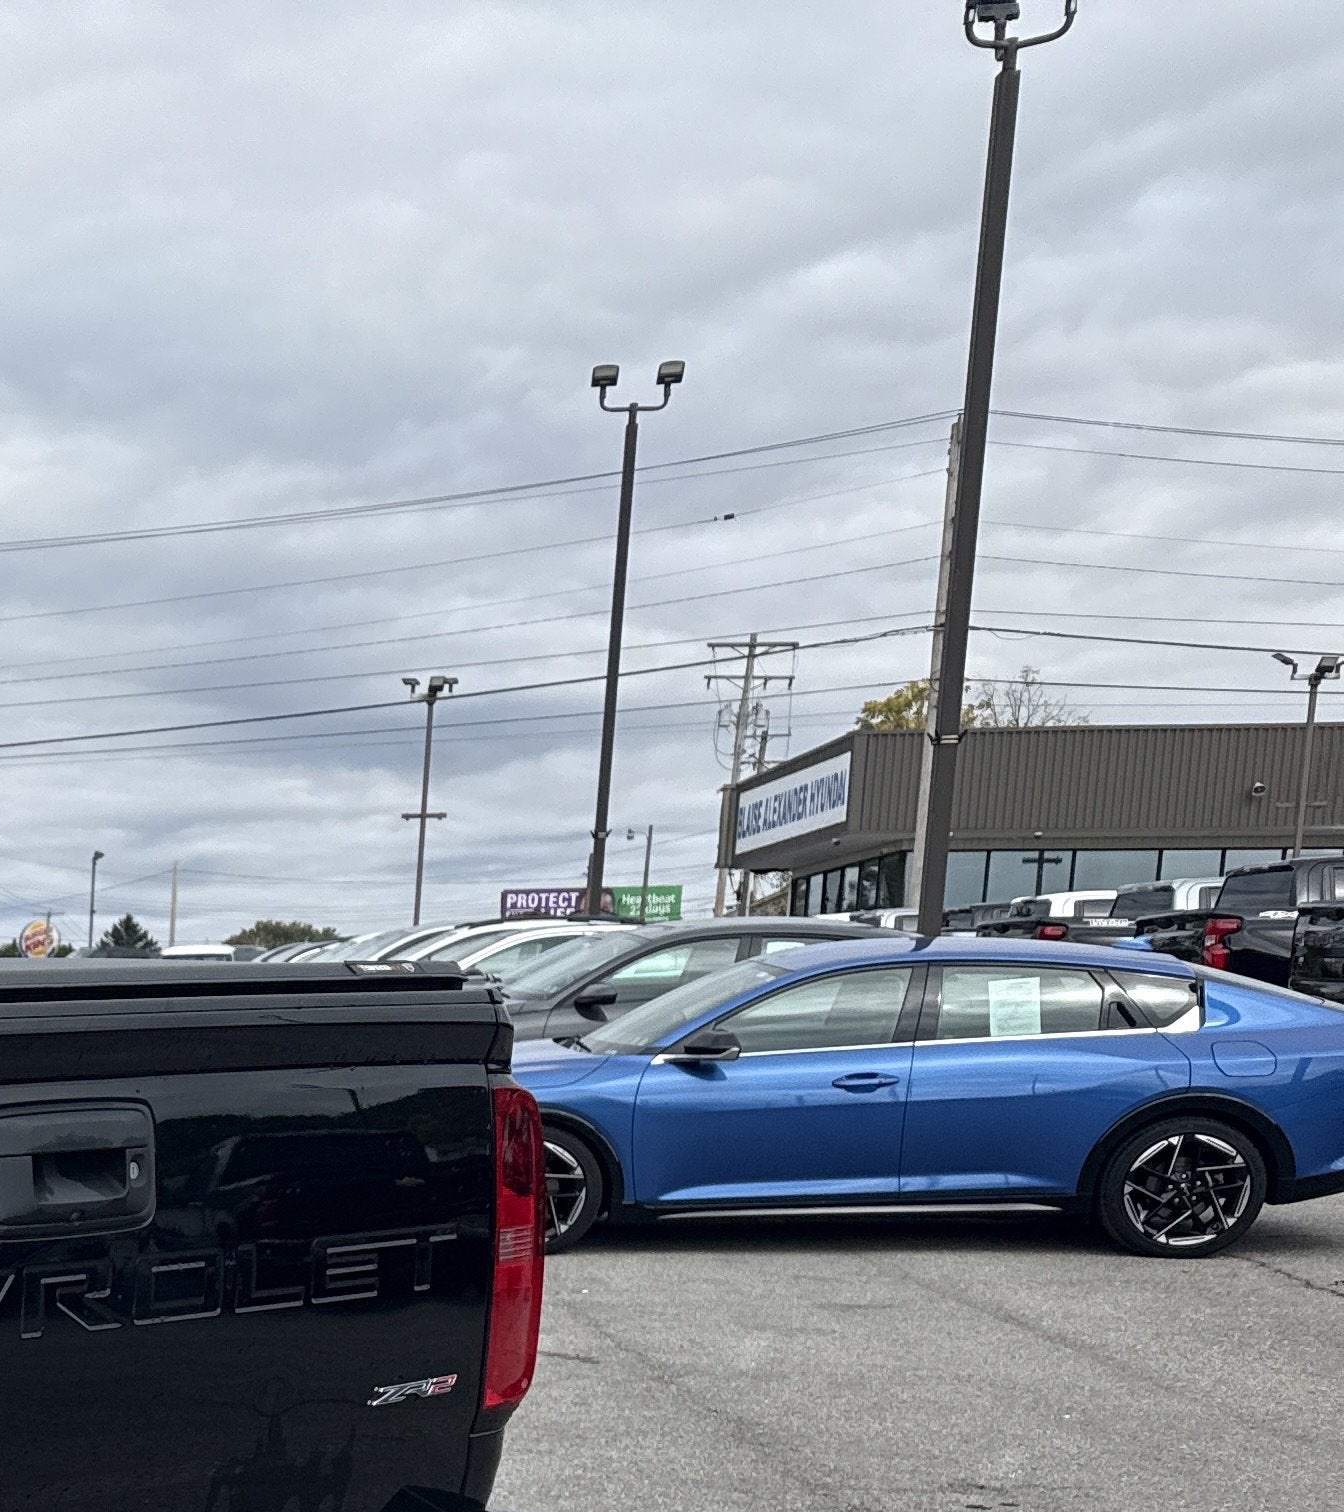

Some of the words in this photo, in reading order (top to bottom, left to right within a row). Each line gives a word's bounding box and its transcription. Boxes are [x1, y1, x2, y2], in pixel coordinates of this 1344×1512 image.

[737, 799, 763, 839] BLAISE
[762, 783, 809, 832] ALEXANDER
[809, 768, 848, 817] HYUNDAI
[506, 891, 580, 908] PROTECT
[367, 1373, 458, 1407] ZR2
